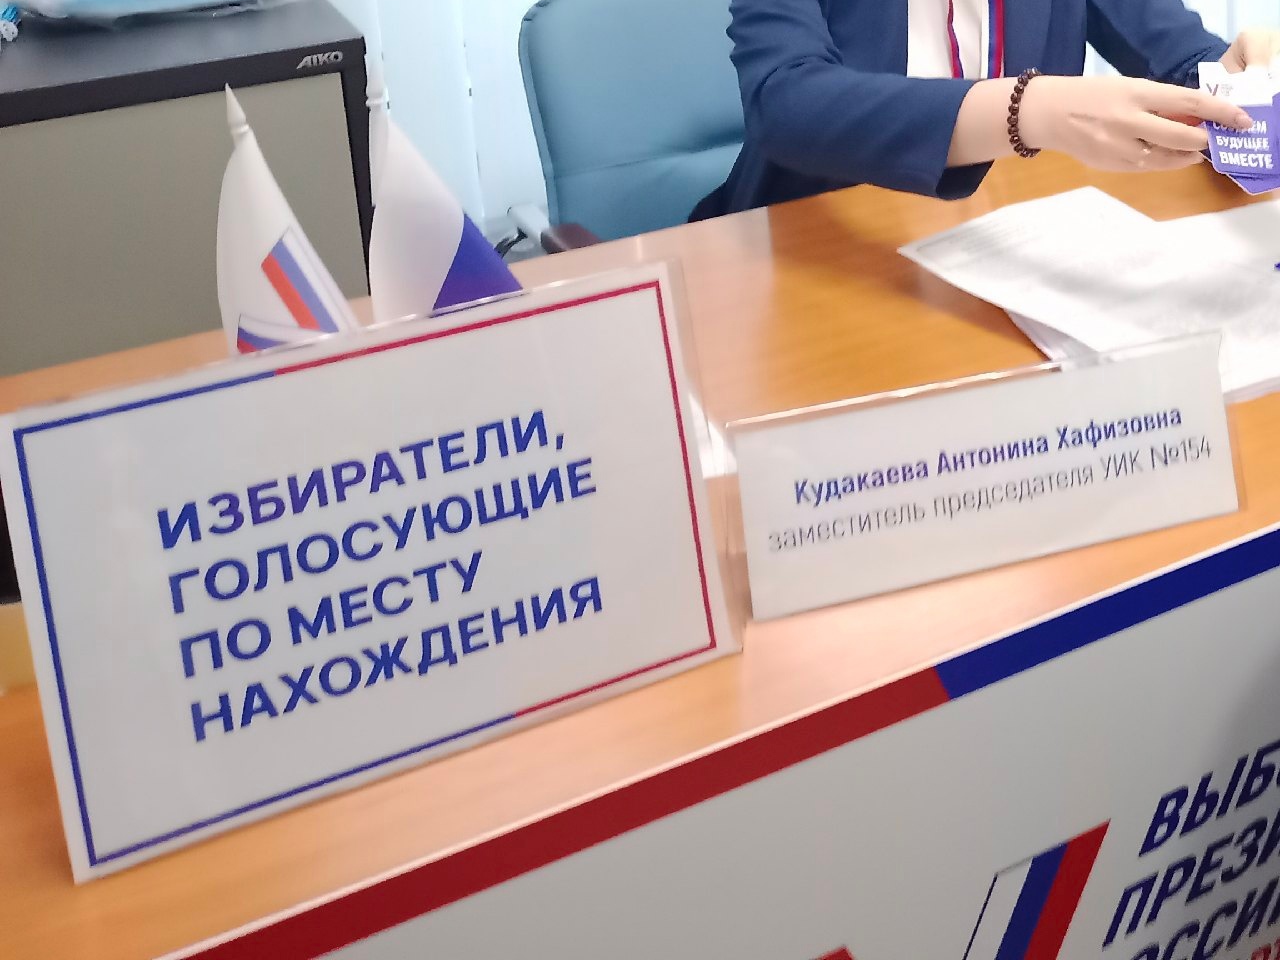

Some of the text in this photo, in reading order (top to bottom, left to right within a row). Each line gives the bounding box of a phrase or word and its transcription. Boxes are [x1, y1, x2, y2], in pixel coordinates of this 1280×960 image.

[296, 50, 343, 69] AIKO
[1216, 135, 1269, 151] БУДУЩЕЕ
[1219, 151, 1274, 169] ВМЕСТЕ
[157, 409, 565, 549] ИЗБИРАТЕЛИ,
[769, 434, 1212, 553] заместитель председателя УИК №154
[794, 407, 1182, 507] Кудакаева Антонина Хафизовна
[168, 457, 597, 615] ГОЛОСУЮЩИЕ
[180, 551, 483, 678] ПО МЕСТУ
[190, 576, 603, 743] НАХОЖДЕНИЯ
